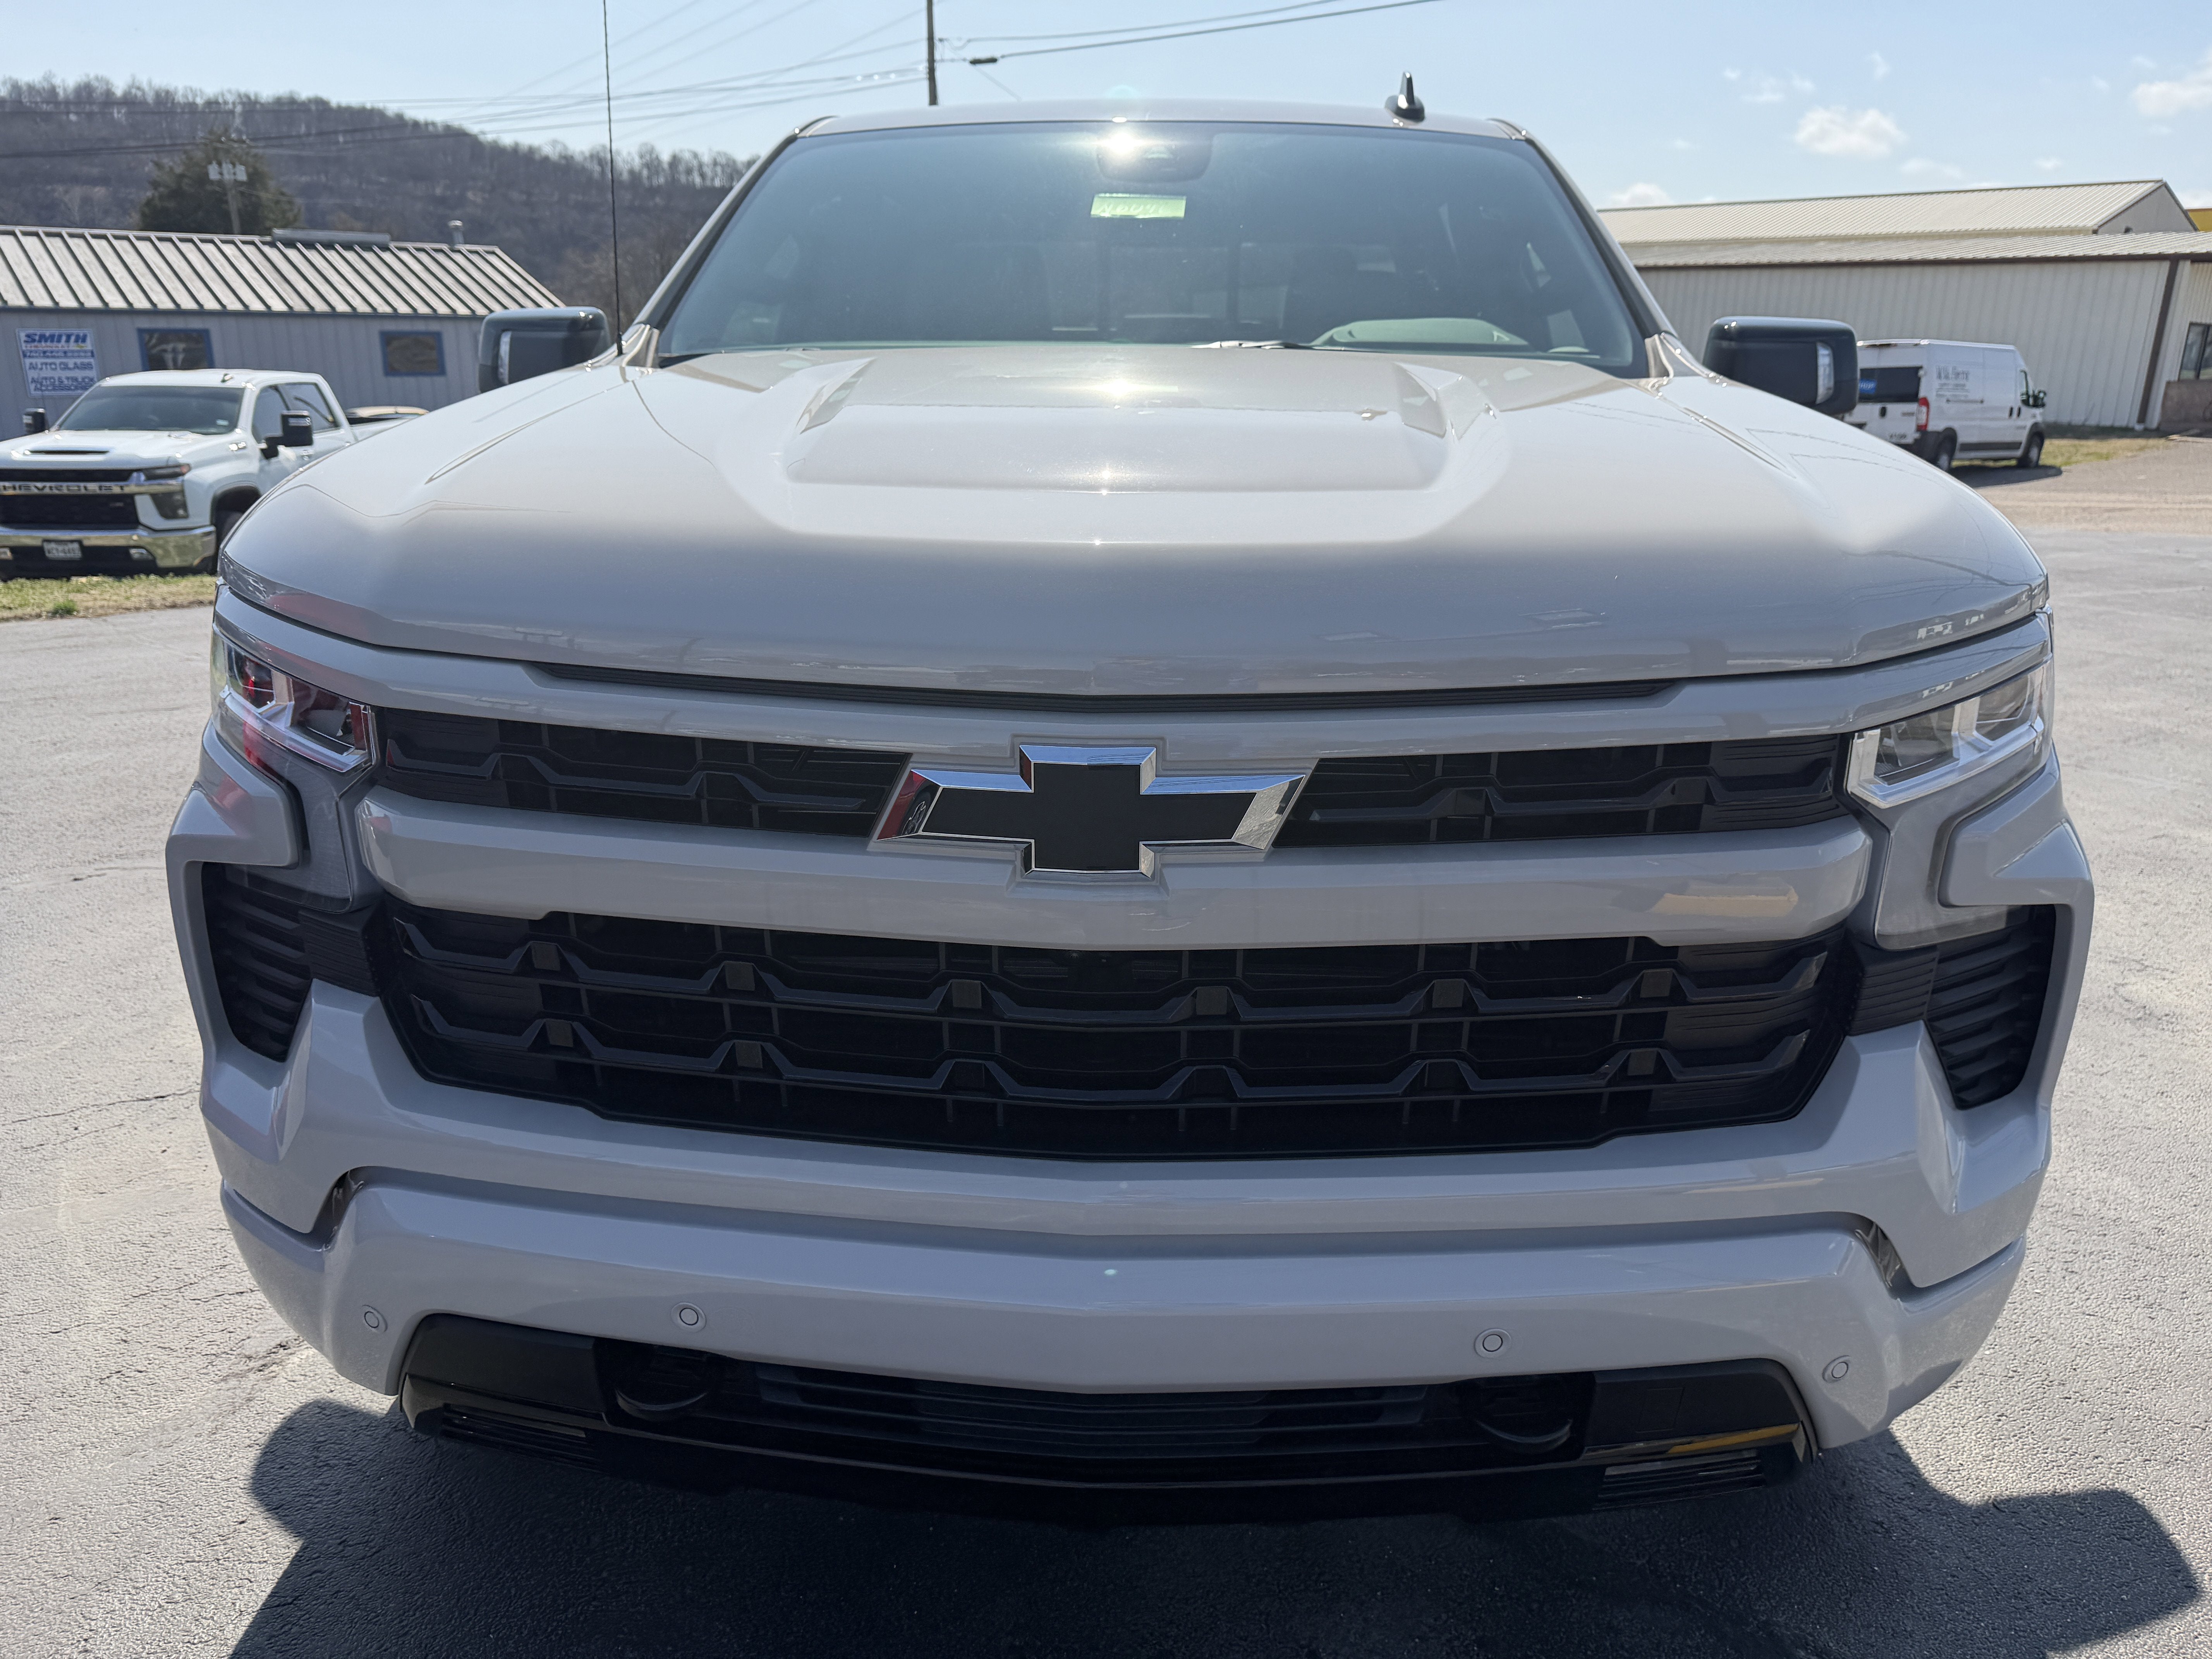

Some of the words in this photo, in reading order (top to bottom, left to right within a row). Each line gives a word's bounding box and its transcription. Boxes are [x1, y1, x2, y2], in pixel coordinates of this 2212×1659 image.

[24, 333, 88, 343] SMITH
[29, 361, 57, 371] AUTO
[59, 361, 93, 371] GLASS
[31, 376, 56, 384] AUTO
[65, 376, 95, 384] TRUCK
